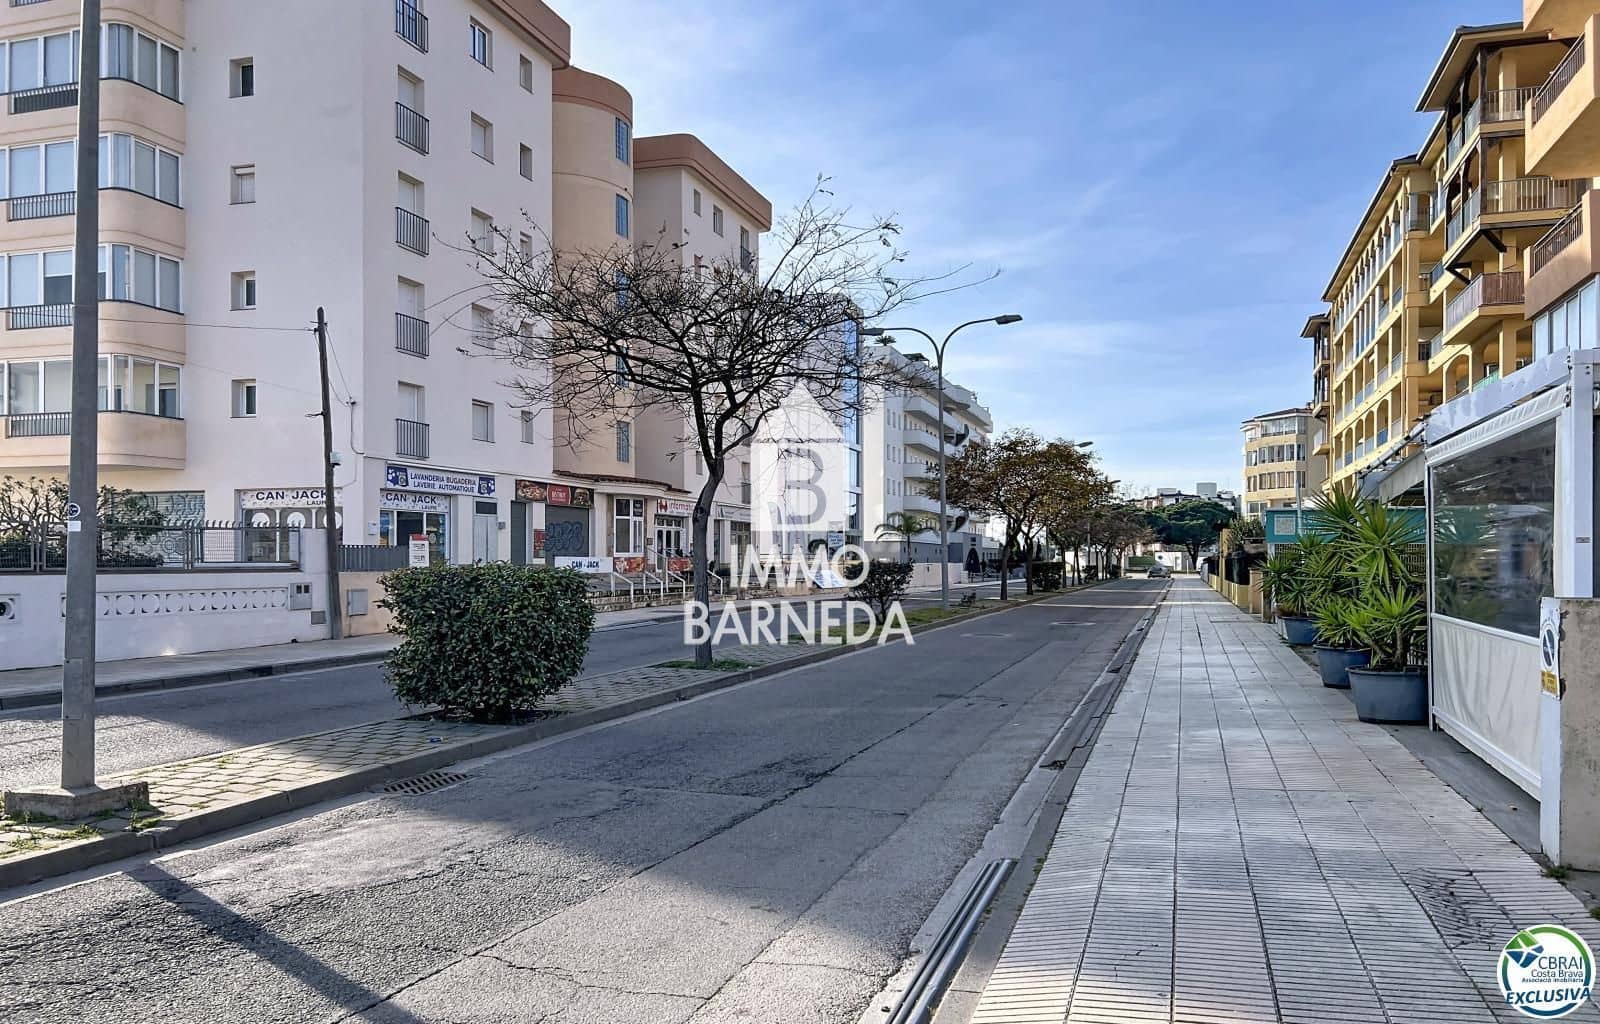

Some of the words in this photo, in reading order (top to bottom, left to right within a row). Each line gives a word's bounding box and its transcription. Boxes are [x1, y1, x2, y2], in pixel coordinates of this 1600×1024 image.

[410, 472, 445, 484] LAVANDERIA
[446, 476, 477, 486] BUGADERIA
[413, 480, 437, 490] LAVERIE
[438, 483, 475, 493] AUTOMATIQUE
[255, 491, 285, 501] CAN
[386, 492, 407, 502] CAN
[411, 495, 437, 504] JACK
[571, 560, 583, 569] CAN
[586, 560, 600, 569] JACK
